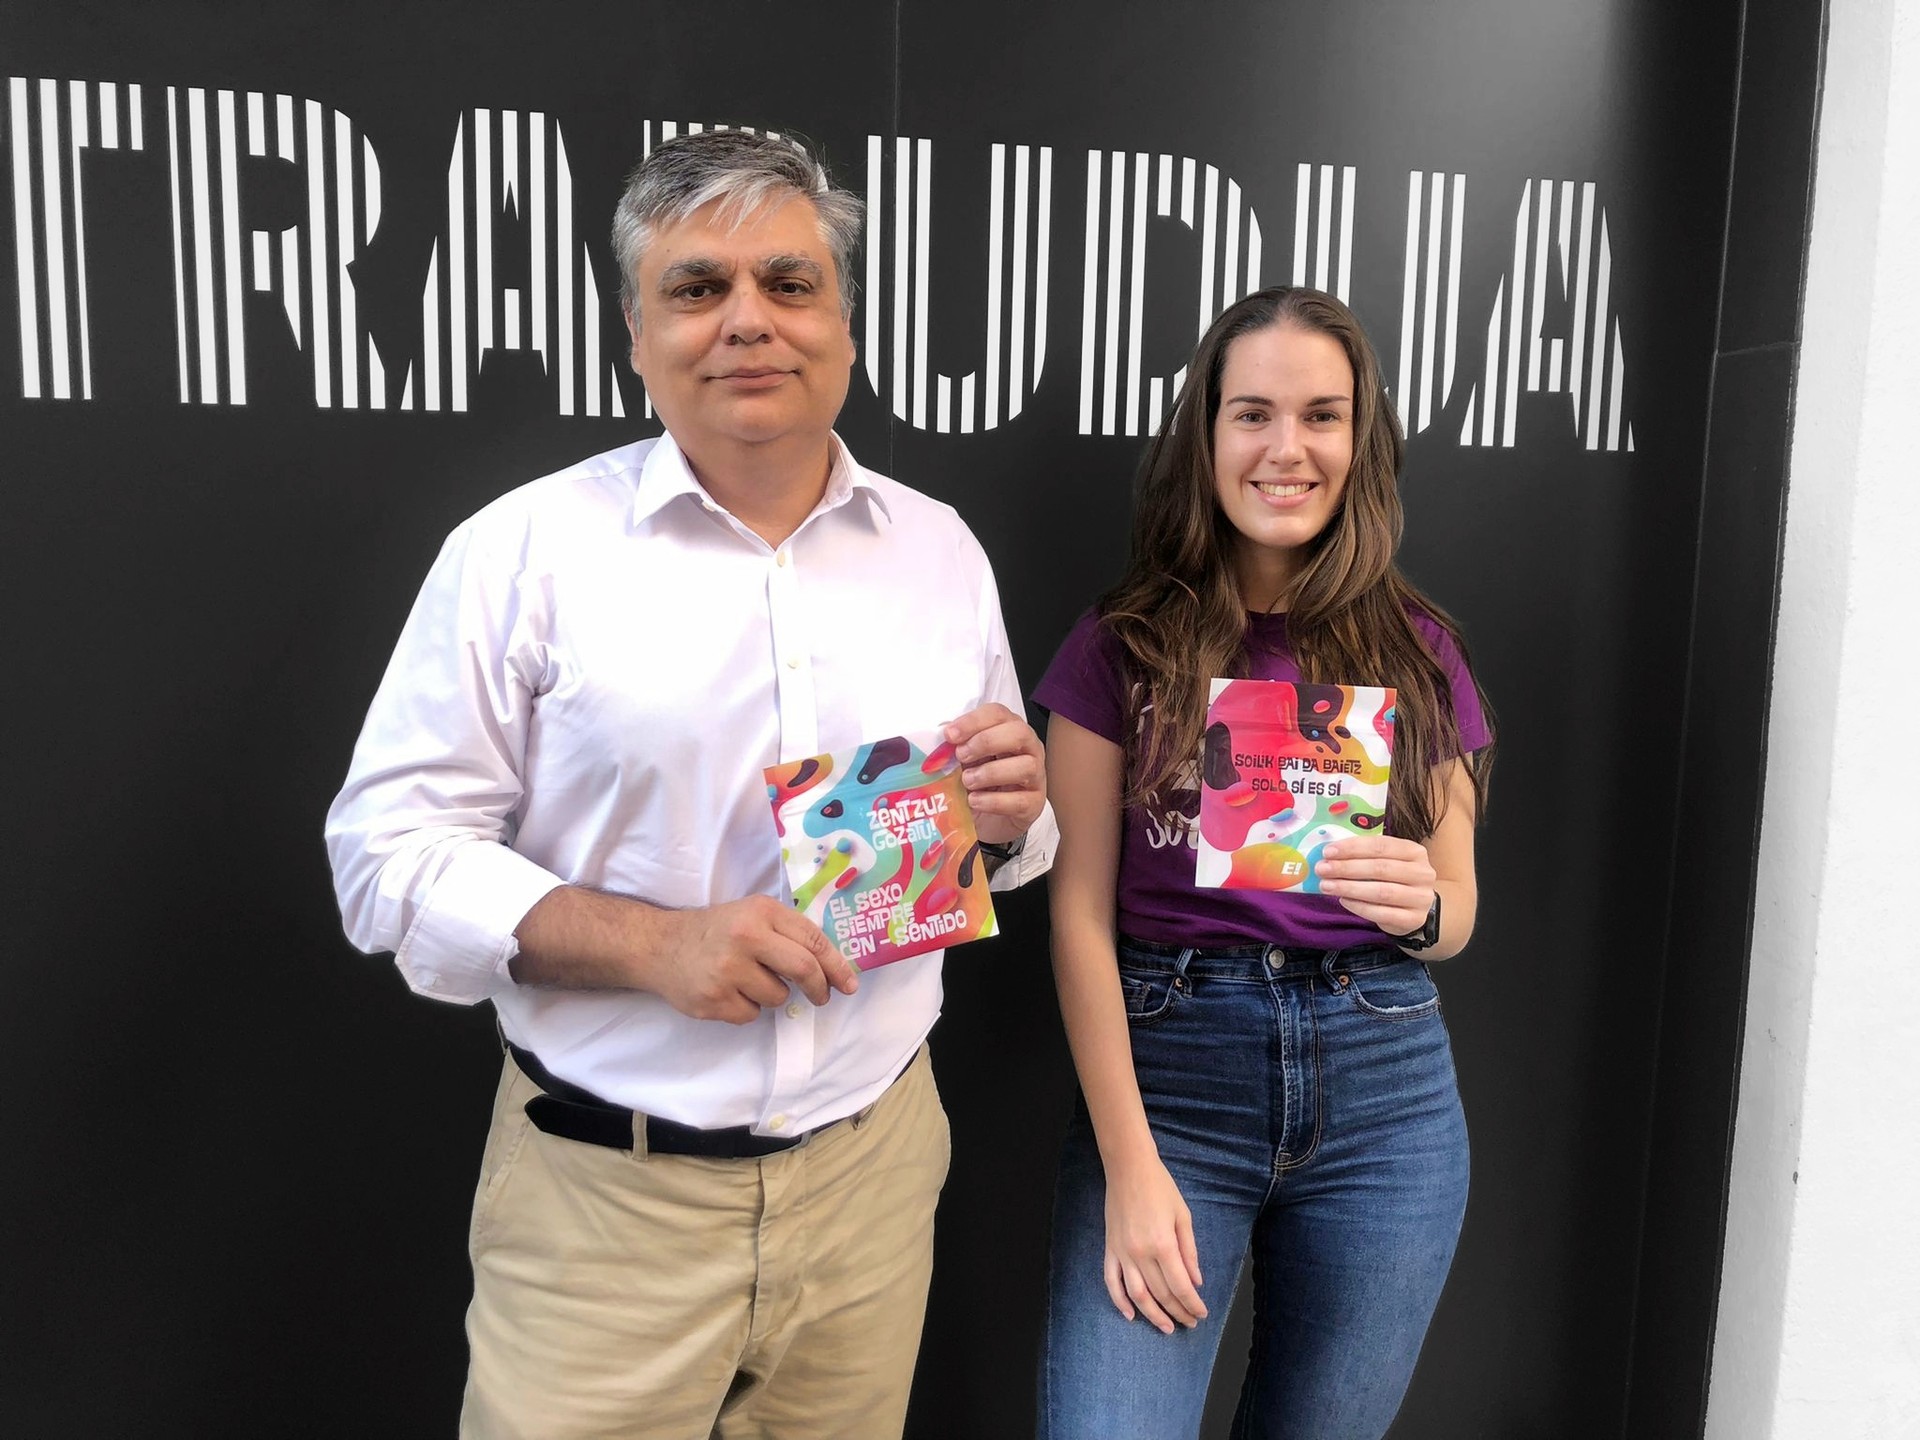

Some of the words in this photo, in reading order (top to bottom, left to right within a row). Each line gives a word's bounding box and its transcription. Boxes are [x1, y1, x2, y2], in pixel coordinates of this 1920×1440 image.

[10, 77, 1635, 452] TRAUDUA
[1302, 757, 1319, 772] DA
[1251, 778, 1288, 792] SOLO
[1291, 777, 1306, 794] SÍ
[1308, 781, 1325, 796] ES
[1328, 779, 1343, 796] SÍ
[829, 896, 852, 919] EL
